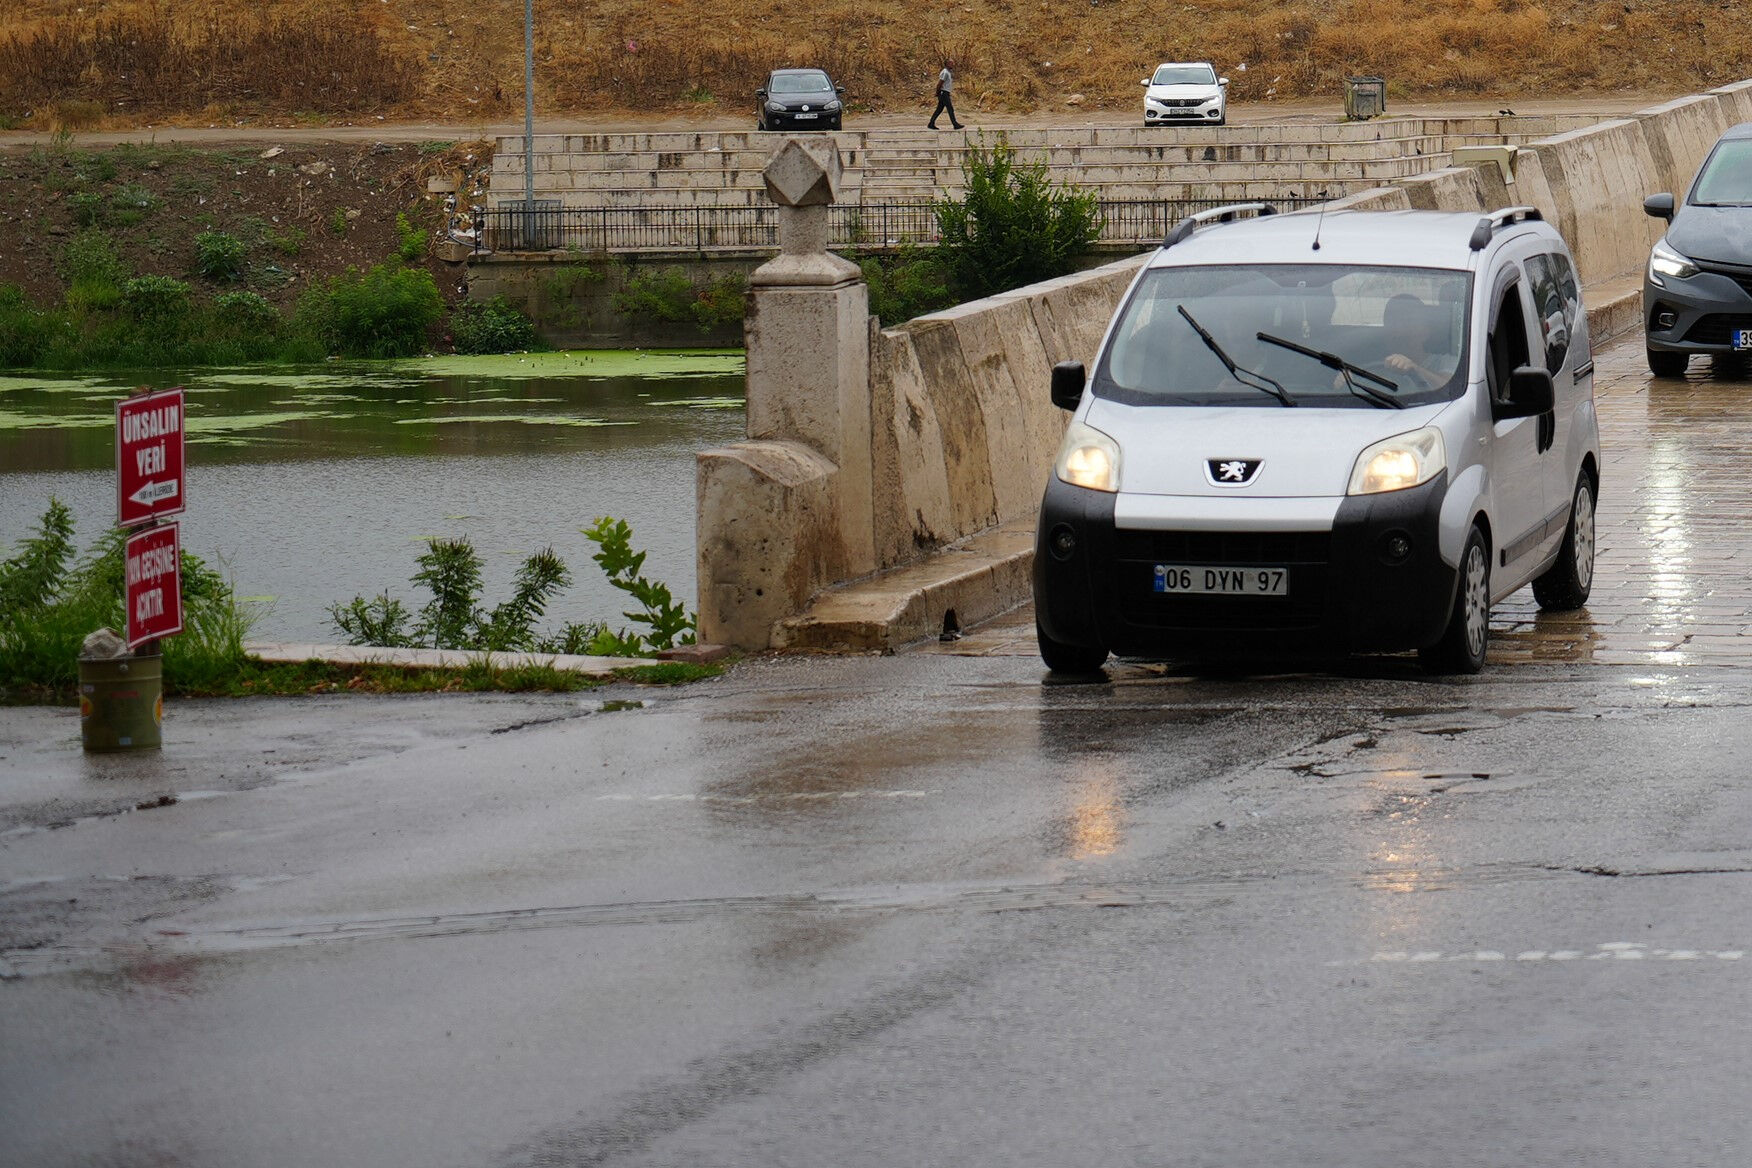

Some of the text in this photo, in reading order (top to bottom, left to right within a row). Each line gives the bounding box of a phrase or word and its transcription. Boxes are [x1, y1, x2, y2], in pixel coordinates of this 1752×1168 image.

[123, 405, 179, 444] ÜNSALIN
[136, 439, 166, 477] YERİ
[1166, 568, 1191, 589] 06
[1204, 570, 1244, 591] DYN
[1258, 571, 1283, 592] 97
